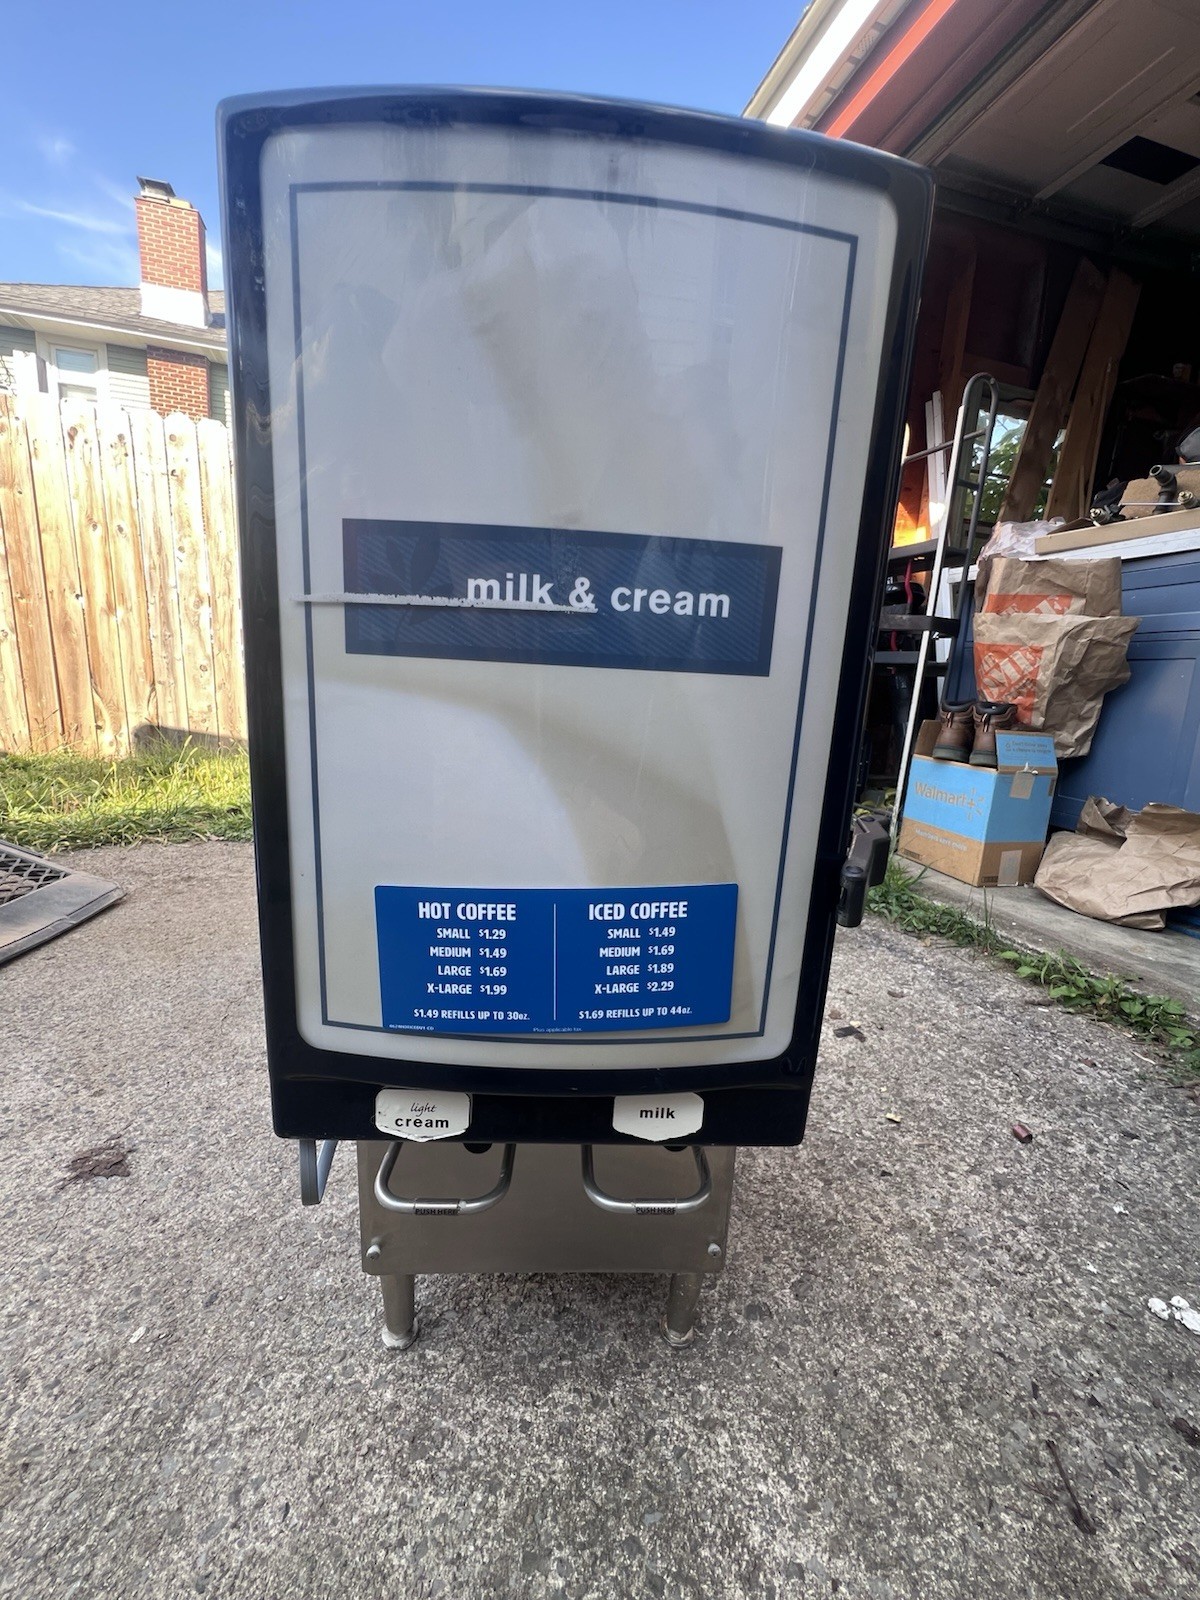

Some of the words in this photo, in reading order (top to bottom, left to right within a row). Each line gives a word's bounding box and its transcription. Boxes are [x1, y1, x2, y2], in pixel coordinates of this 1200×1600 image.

[467, 572, 554, 606] milk
[568, 577, 596, 608] &
[610, 585, 730, 618] cream
[418, 902, 451, 920] HOT
[456, 903, 517, 921] COFFEE
[588, 903, 625, 920] ICED
[630, 901, 688, 920] COFFEE
[436, 928, 471, 939] SMALL
[478, 929, 507, 940] $1.29
[607, 928, 641, 939] SMALL
[649, 926, 676, 938] $1.49
[429, 946, 472, 958] MEDIUM
[479, 947, 507, 958] $1.49
[599, 946, 641, 957] MEDIUM
[648, 945, 675, 956] $1.69
[437, 965, 472, 976] LARGE
[479, 966, 507, 977] $1.69
[606, 964, 640, 975] LARGE
[647, 963, 675, 974] $1.89
[427, 983, 473, 995] X-LARGE
[479, 984, 507, 995] $1.99
[594, 983, 640, 994] X-LARGE
[646, 981, 675, 992] $2.29
[413, 1008, 439, 1018] $1.49
[441, 1010, 475, 1020] REFILLS
[477, 1011, 490, 1020] UP
[493, 1011, 505, 1020] TO
[506, 1011, 530, 1021] 30oz.
[579, 1010, 604, 1019] $1.69
[606, 1008, 640, 1018] REFILLS
[642, 1007, 654, 1017] UP
[656, 1006, 668, 1016] TO
[669, 1005, 692, 1015] 44oz.
[410, 1102, 437, 1117] light
[639, 1106, 675, 1120] milk
[395, 1118, 449, 1128] cream
[635, 1207, 656, 1215] PUSH
